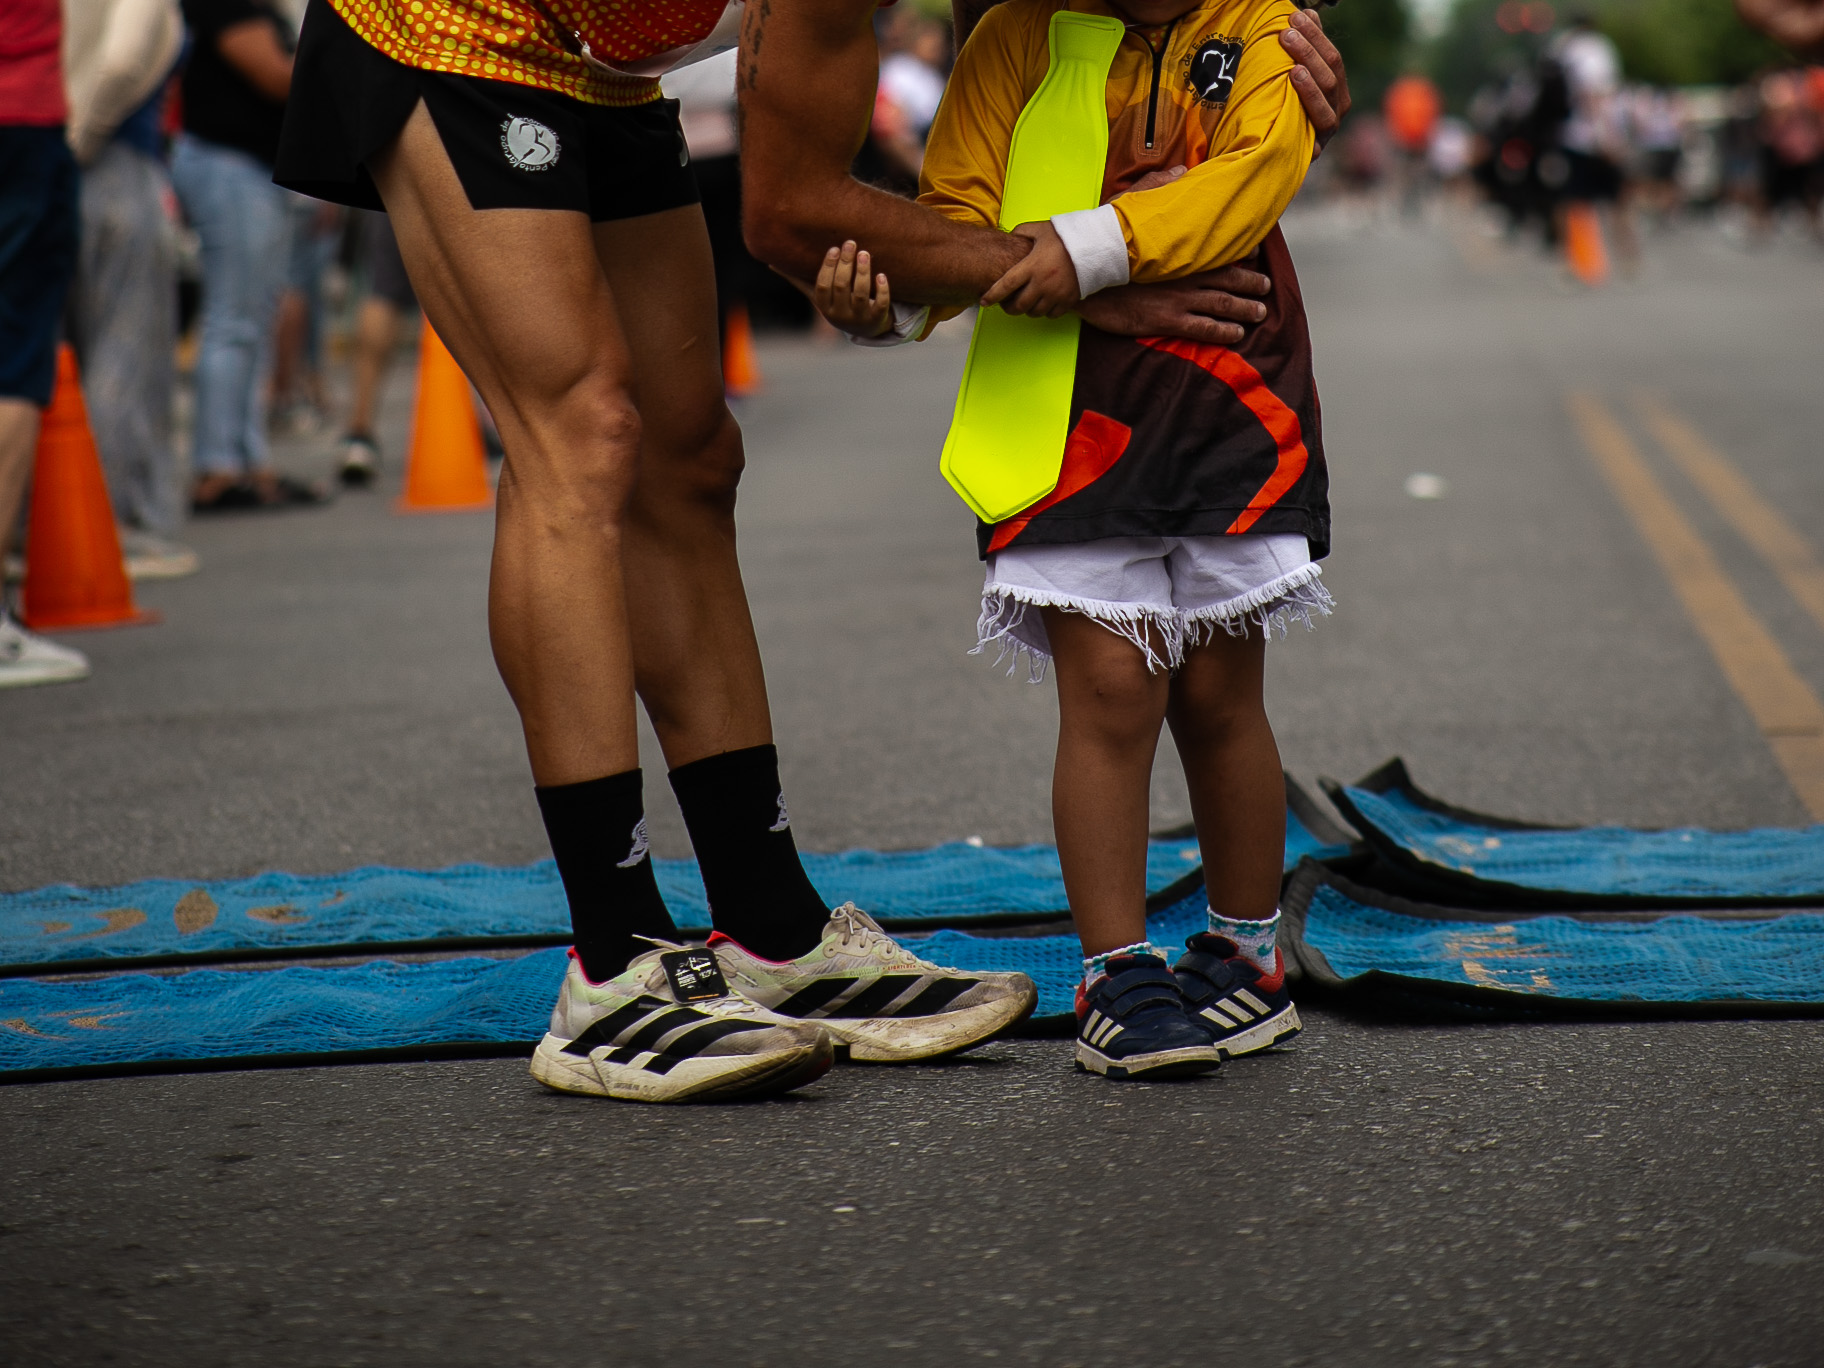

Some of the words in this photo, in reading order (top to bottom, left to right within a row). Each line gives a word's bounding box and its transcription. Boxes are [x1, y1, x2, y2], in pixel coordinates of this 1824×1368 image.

[1181, 53, 1195, 67] de
[1200, 100, 1227, 112] enta
[500, 120, 510, 132] de
[500, 135, 518, 164] Grupo
